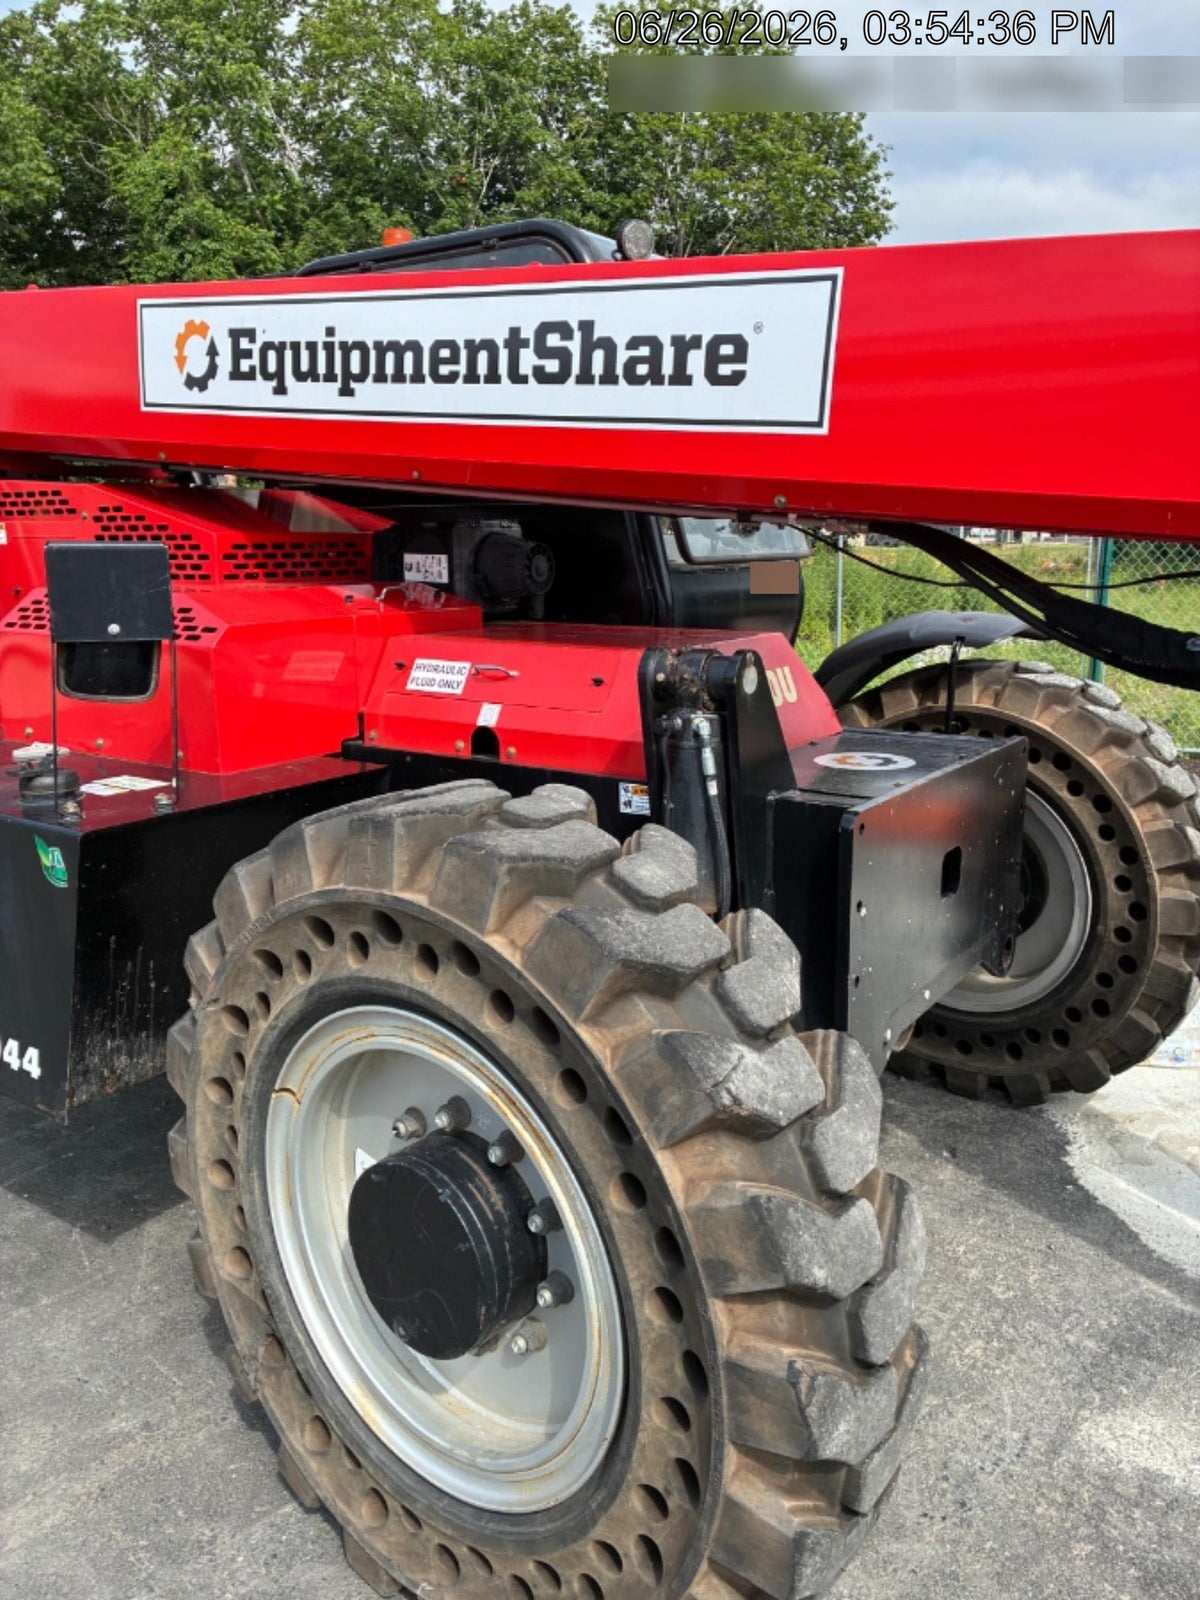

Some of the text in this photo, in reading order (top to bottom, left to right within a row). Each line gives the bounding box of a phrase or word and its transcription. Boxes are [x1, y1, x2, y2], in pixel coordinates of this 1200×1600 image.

[228, 319, 748, 397] EquipmentShare
[410, 677, 463, 690] FLUID ONLY
[413, 663, 467, 676] HYDRAULIC
[0, 1037, 42, 1080] 44
